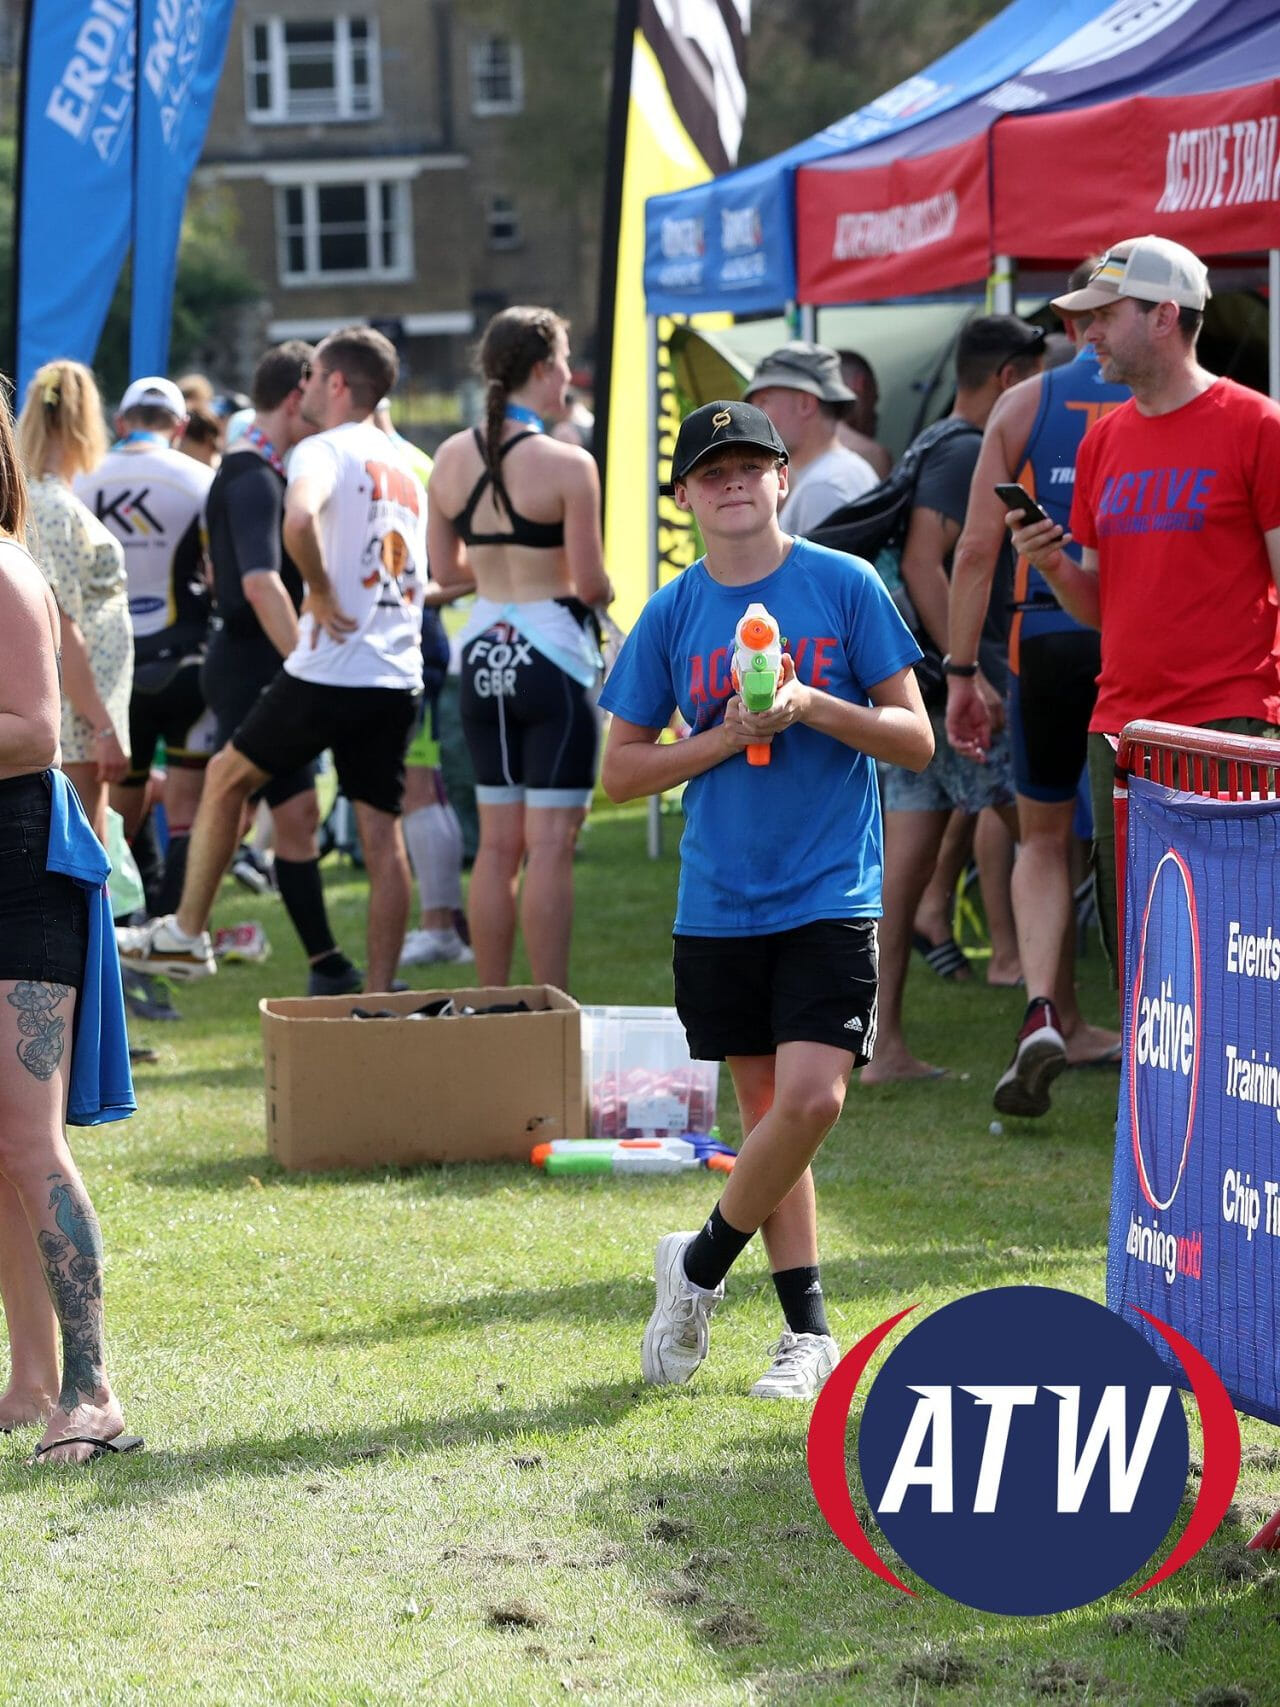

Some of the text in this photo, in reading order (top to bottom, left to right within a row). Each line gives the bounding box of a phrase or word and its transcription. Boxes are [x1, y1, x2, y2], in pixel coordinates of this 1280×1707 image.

[1099, 468, 1217, 515] ACTIVE
[467, 639, 533, 669] FOX
[689, 637, 838, 705] ACVE
[474, 668, 517, 698] GBR
[1137, 974, 1194, 1076] active
[1223, 1168, 1261, 1241] Chip
